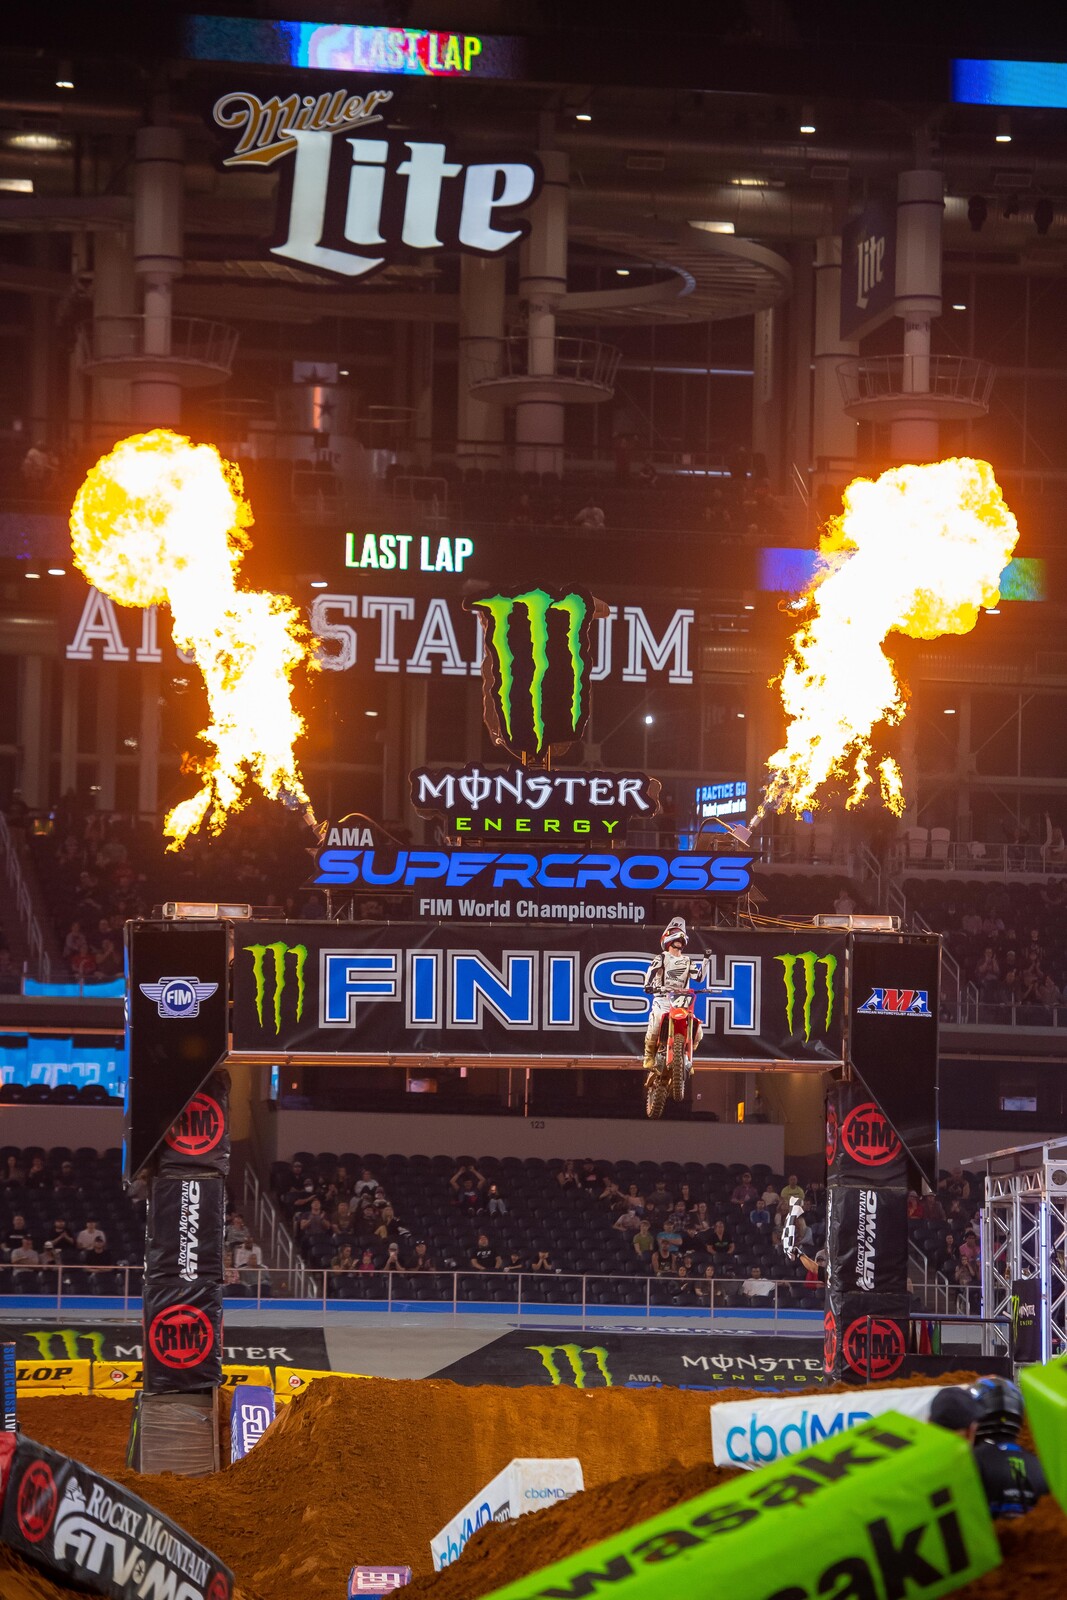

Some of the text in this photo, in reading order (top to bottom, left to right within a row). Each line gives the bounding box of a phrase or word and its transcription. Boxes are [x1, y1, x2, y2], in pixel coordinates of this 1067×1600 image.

[352, 28, 482, 72] LAST LAP
[213, 89, 393, 154] Miller
[270, 129, 535, 276] Lite
[345, 532, 474, 572] LAST LAP
[418, 769, 650, 811] MONSTER
[327, 827, 374, 847] AMA
[456, 816, 619, 834] ENERGY
[313, 849, 754, 892] SUPERCROSS
[419, 898, 646, 924] FIM World Championship
[166, 989, 191, 1006] FIM
[319, 948, 762, 1036] FINISH
[857, 987, 932, 1013] AMA
[531, 1120, 545, 1129] 123
[178, 1180, 190, 1267] ROCKY MOUNTAIN
[856, 1189, 867, 1275] ROCKY MOUNTAIN
[162, 1323, 200, 1351] RM
[855, 1333, 893, 1360] RM
[628, 1373, 662, 1383] AMA
[712, 1373, 825, 1382] ENERGY
[525, 1487, 566, 1499] cbdMD
[86, 1483, 212, 1588] ROCKY MOUNTAIN
